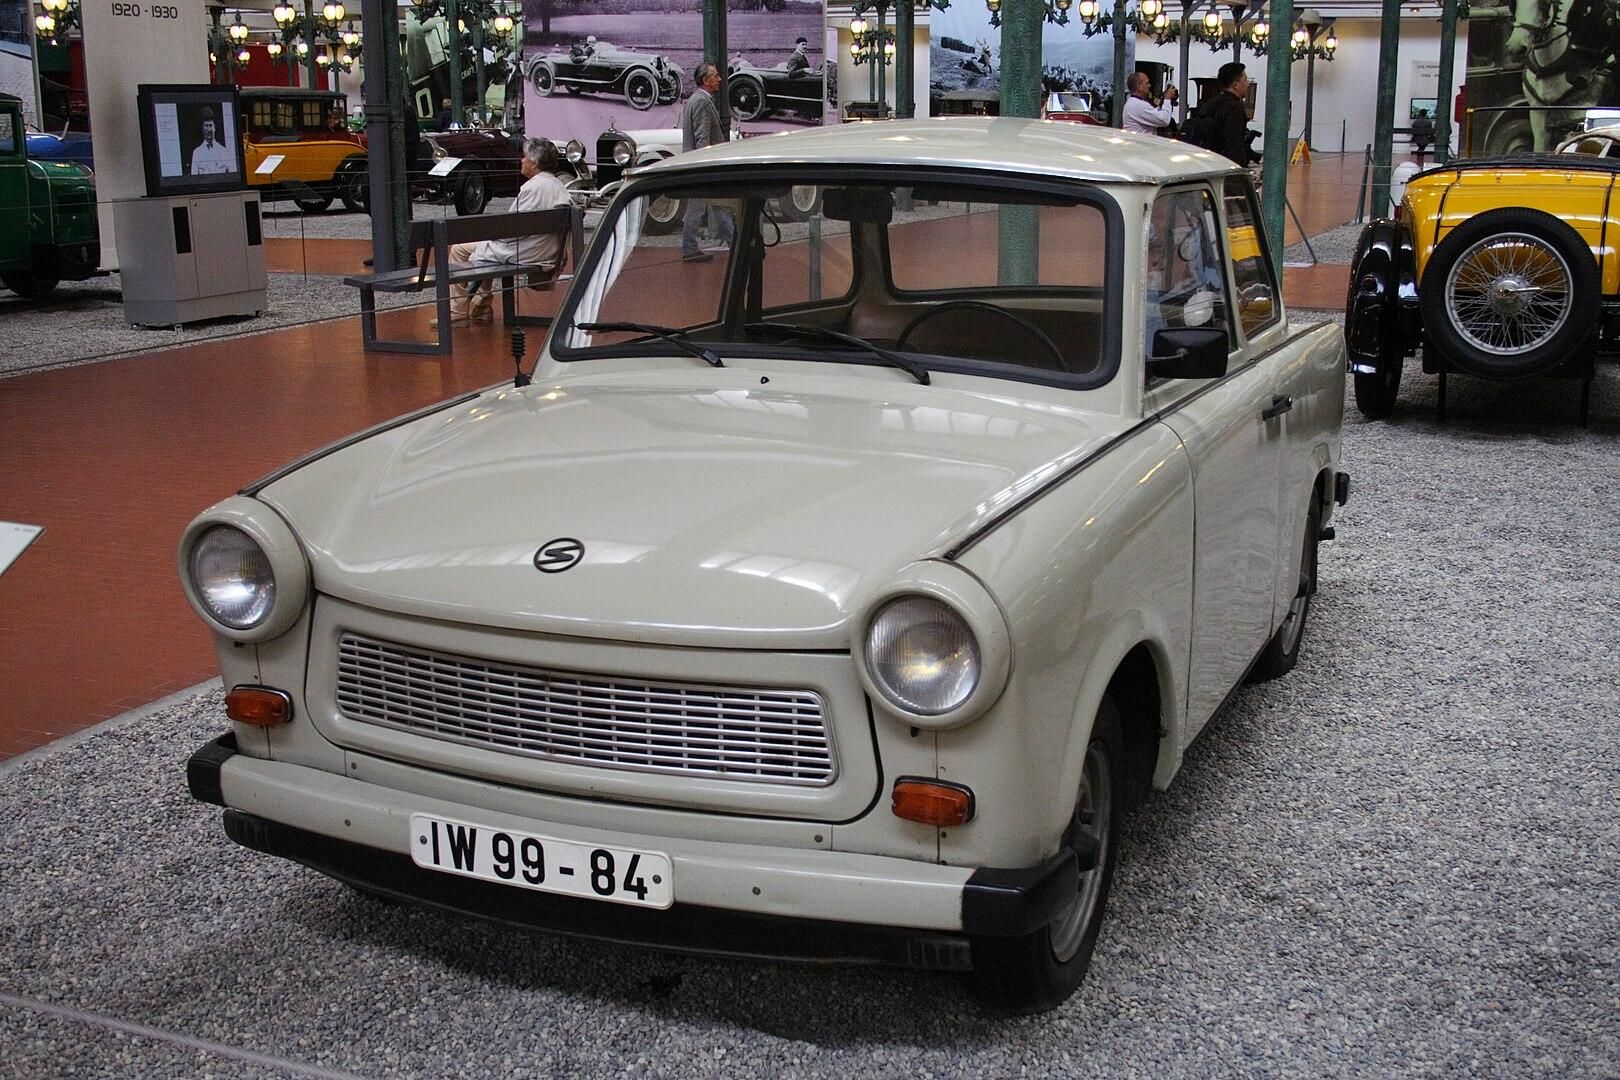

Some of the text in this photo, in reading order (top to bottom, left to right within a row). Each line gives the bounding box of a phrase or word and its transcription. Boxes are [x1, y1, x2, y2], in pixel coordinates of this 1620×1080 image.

[111, 3, 140, 17] 1920
[151, 5, 178, 19] 1930
[431, 821, 477, 872] IW
